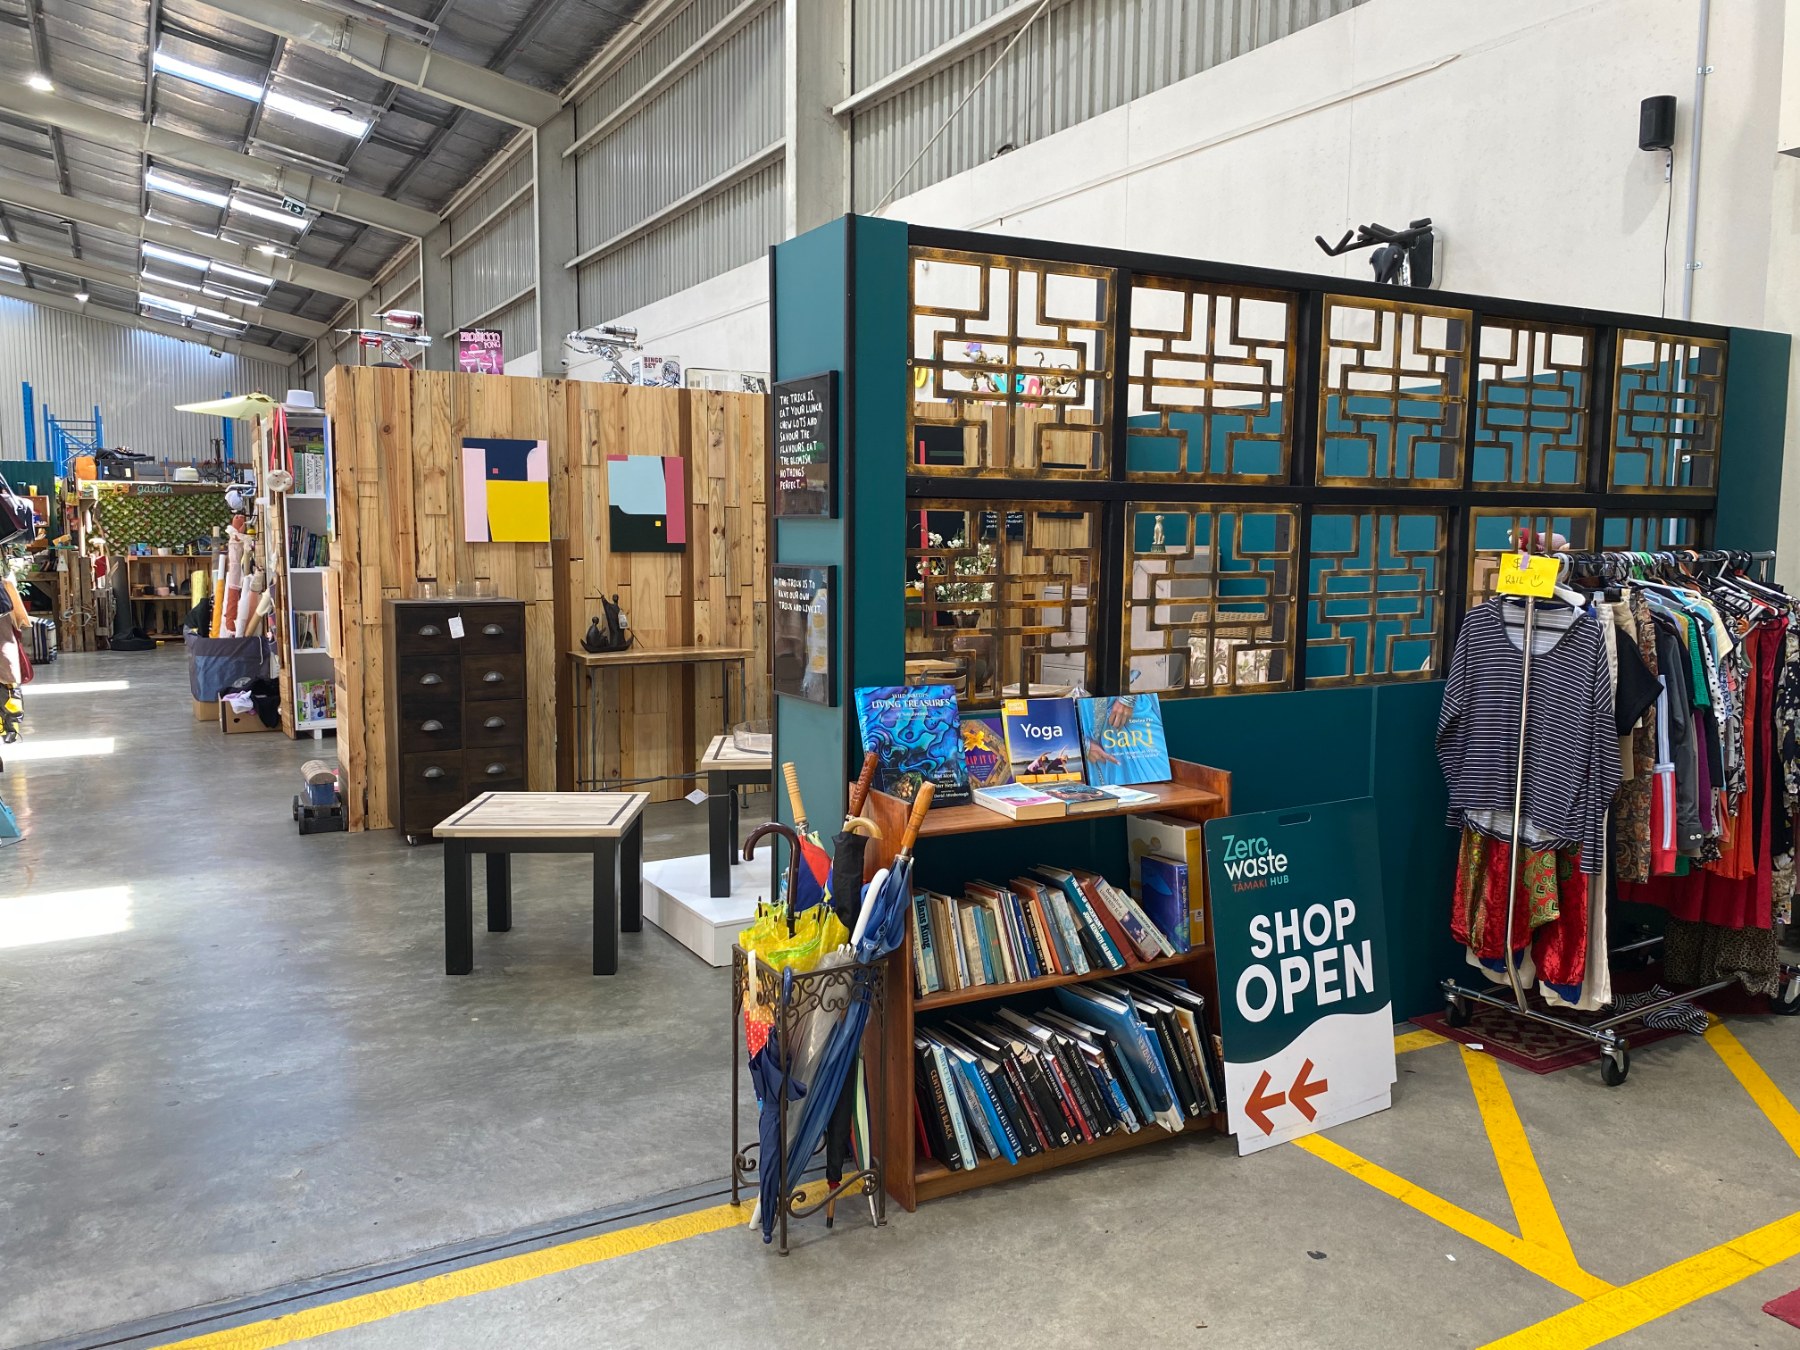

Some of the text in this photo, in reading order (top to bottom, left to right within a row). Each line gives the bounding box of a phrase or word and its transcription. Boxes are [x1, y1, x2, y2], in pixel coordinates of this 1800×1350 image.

[780, 395, 789, 405] THE
[790, 393, 806, 403] TRICK
[780, 407, 789, 418] EAT
[790, 404, 805, 416] YOUR
[780, 416, 817, 429] CHEW LOTS AND
[780, 430, 810, 442] SAVOUR THE
[807, 441, 817, 451] EAT
[780, 456, 789, 465] THE
[137, 484, 173, 496] garden
[787, 578, 801, 588] TRICK
[802, 579, 808, 588] IS
[808, 579, 816, 589] TO
[871, 698, 950, 709] LIVING TREASURES
[1020, 723, 1063, 740] Yoga
[1222, 834, 1268, 862] Zero
[1224, 849, 1288, 881] waste
[1270, 875, 1289, 886] HUB
[917, 900, 927, 924] Hans
[1071, 877, 1079, 888] THE
[1085, 902, 1105, 932] UNCERTAINTY
[1249, 898, 1356, 959] SHOP
[1083, 911, 1119, 968] JOHN KENNETH GALBRAITH
[1236, 939, 1374, 1023] OPEN
[939, 1053, 955, 1097] BRYCE HART
[930, 1069, 953, 1140] CENTURY IN BLACK
[979, 1068, 993, 1094] LEGENDS
[995, 1102, 1003, 1115] THE
[1000, 1115, 1008, 1126] ALL
[1005, 1126, 1018, 1147] BLACKS
